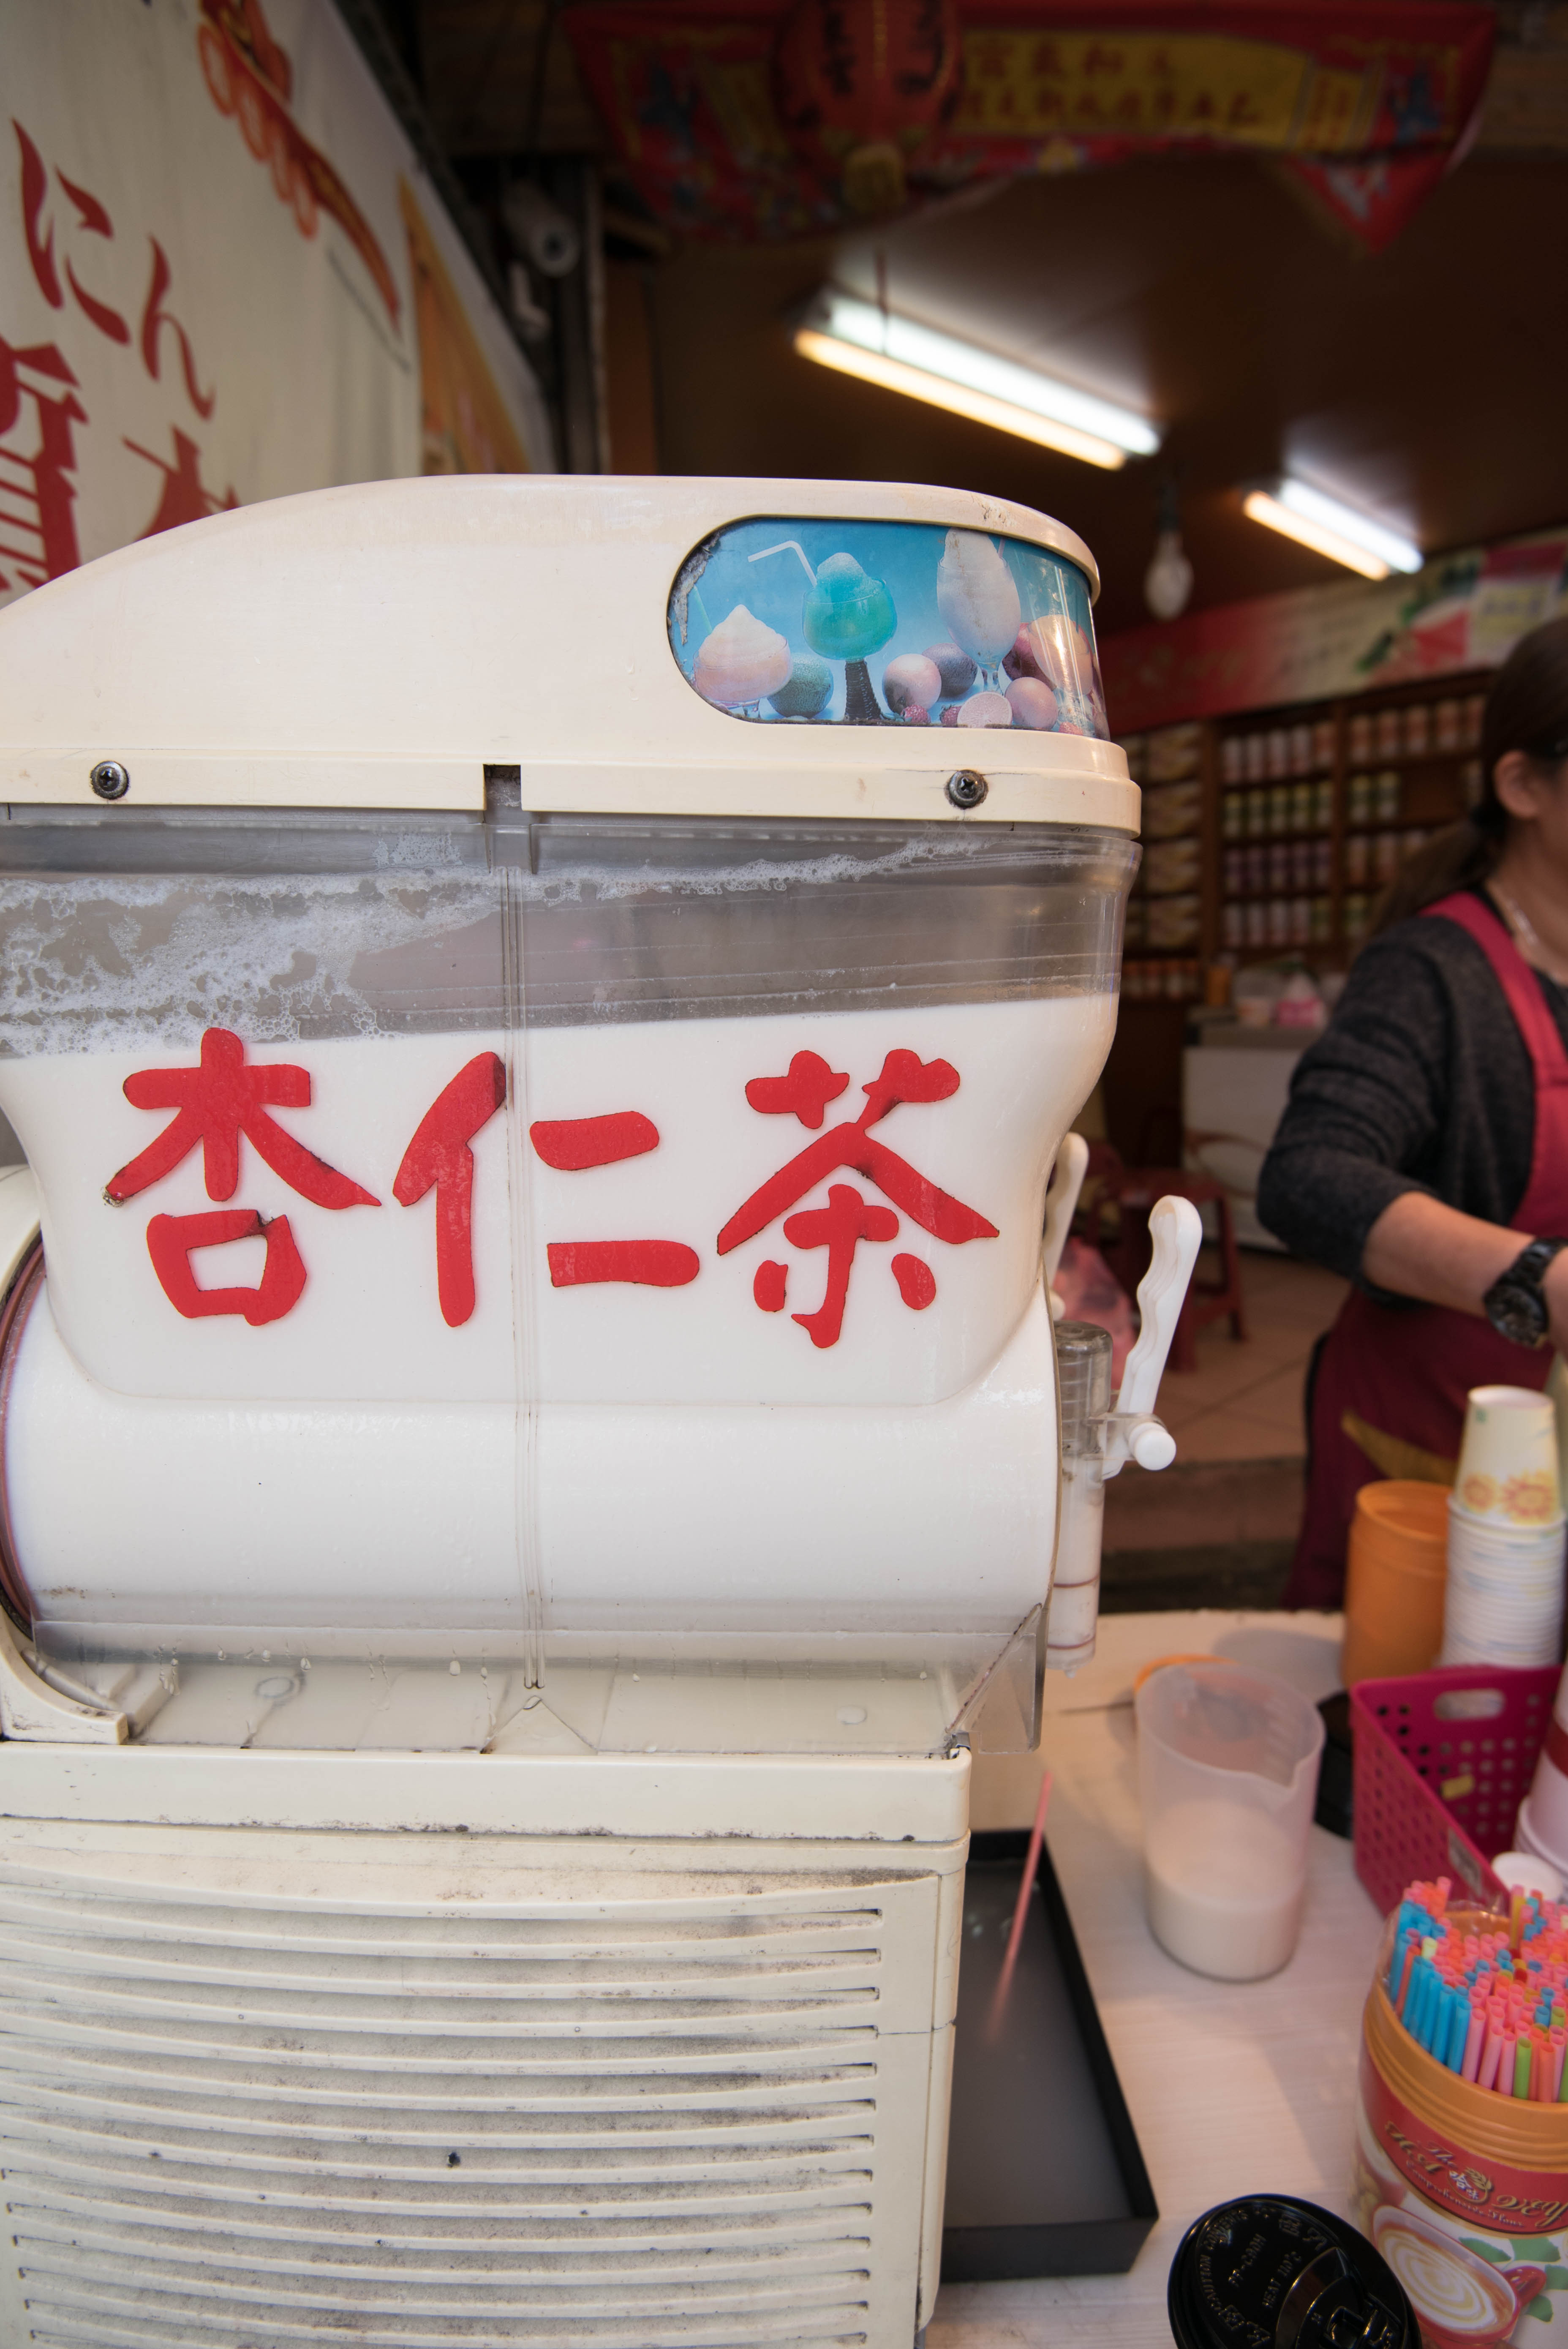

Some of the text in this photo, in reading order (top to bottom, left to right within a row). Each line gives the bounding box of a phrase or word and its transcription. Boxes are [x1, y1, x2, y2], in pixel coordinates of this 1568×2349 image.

[103, 1027, 1000, 1348] 杏仁茶
[1200, 2255, 1222, 2311] CAUTION
[1262, 2278, 1281, 2308] HEAT
